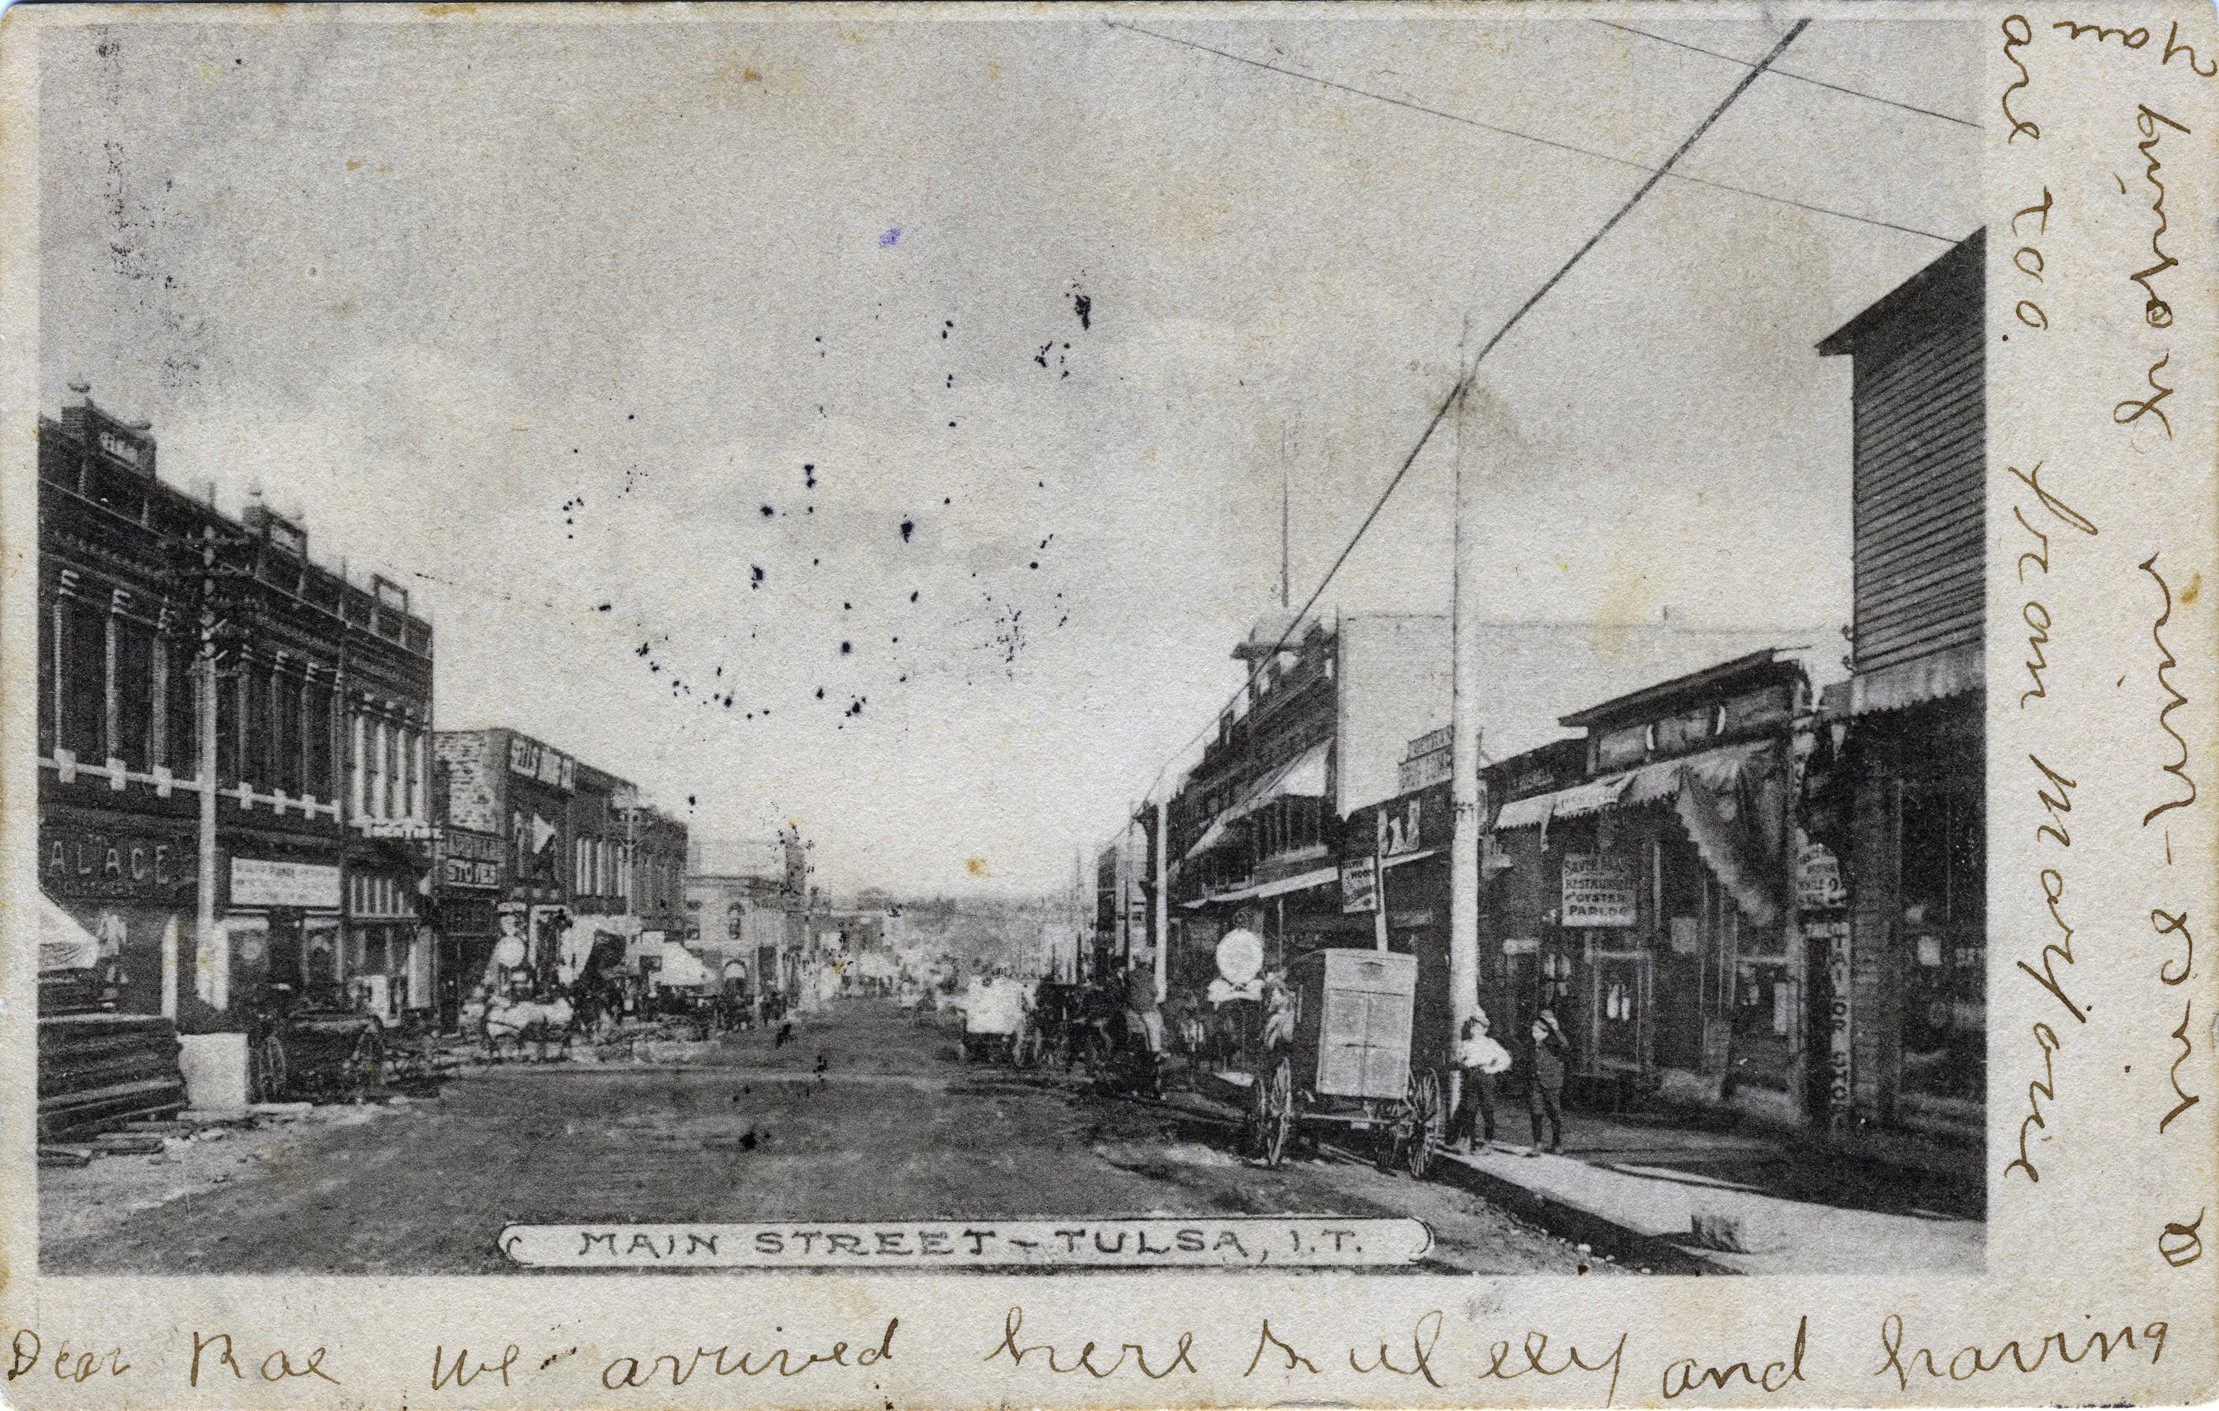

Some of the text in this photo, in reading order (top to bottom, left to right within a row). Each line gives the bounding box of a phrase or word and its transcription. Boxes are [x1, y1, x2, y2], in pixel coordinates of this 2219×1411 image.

[2000, 13, 2040, 145] are
[2157, 1206, 2206, 1268] a
[6, 1329, 131, 1383] Dear
[601, 1317, 899, 1387] arrived
[983, 1306, 1198, 1379] here
[1661, 1315, 1808, 1400] and
[1873, 1313, 2169, 1392] having
